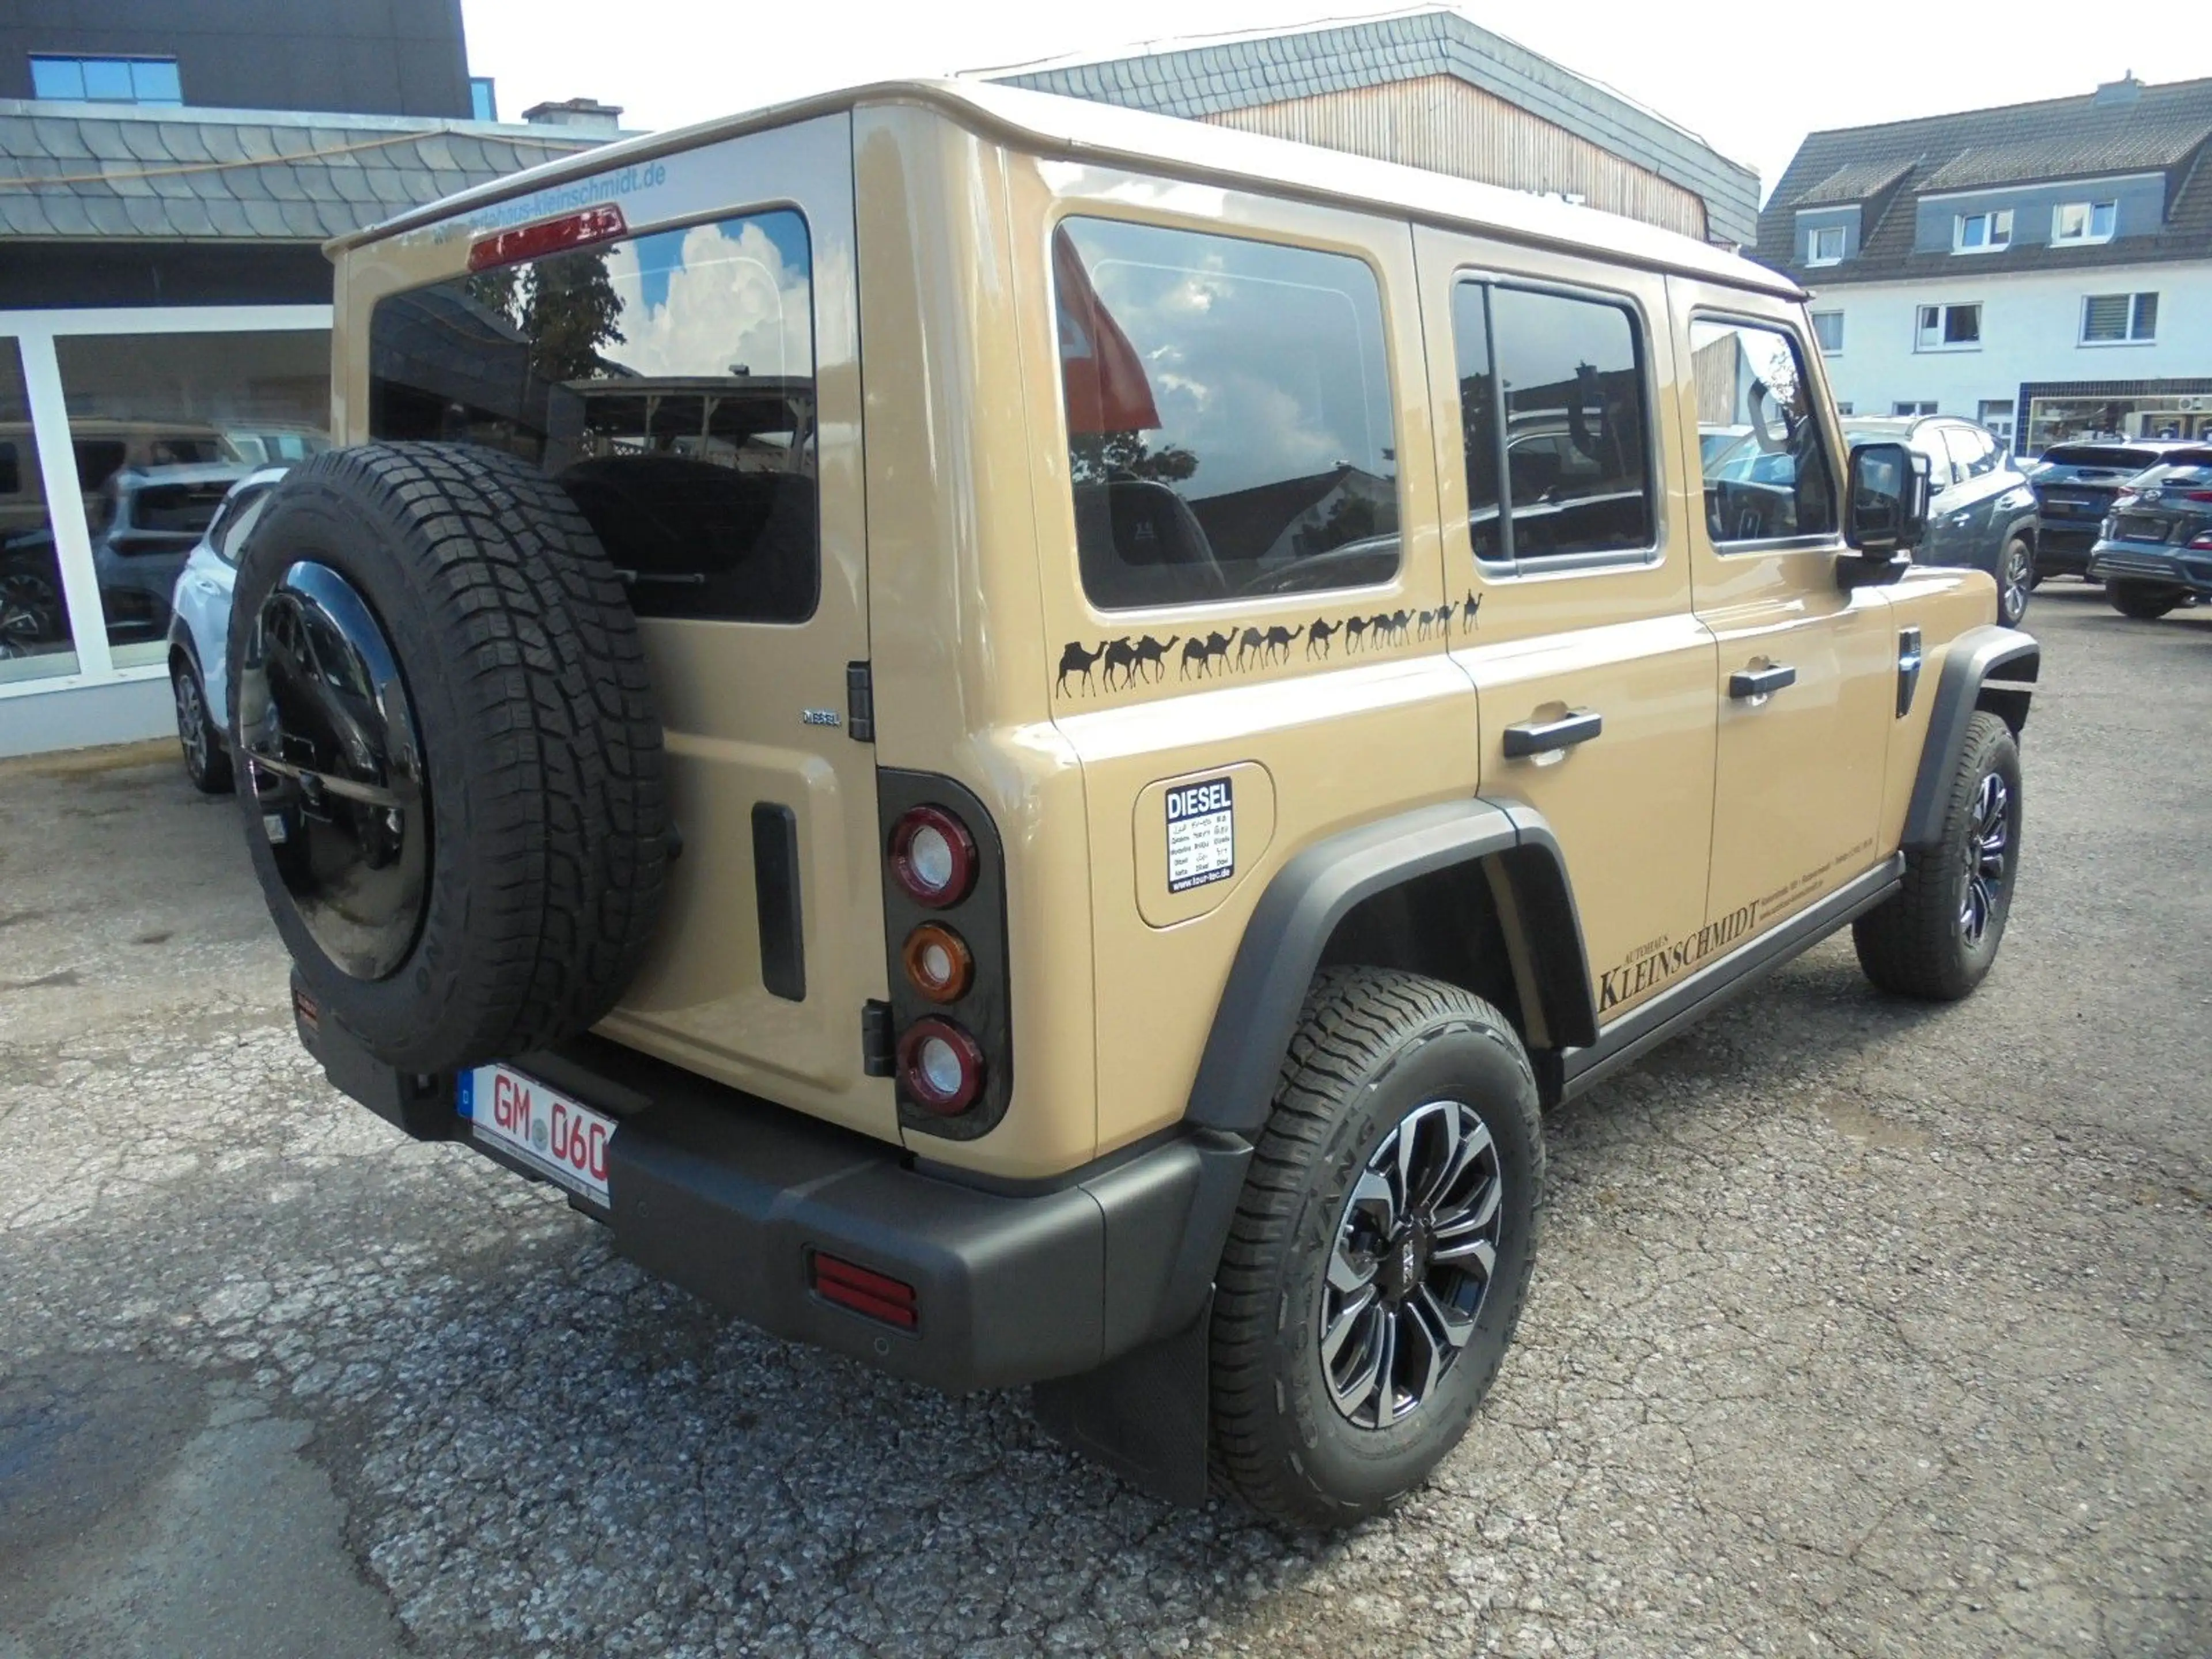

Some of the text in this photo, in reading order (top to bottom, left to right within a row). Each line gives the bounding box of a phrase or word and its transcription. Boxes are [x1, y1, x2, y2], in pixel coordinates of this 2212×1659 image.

[433, 161, 666, 246] wautohaus-kleinschmidt.de
[1168, 783, 1232, 819] DIESEL
[1597, 899, 1760, 1013] KLEINSCHMIDT
[494, 1073, 611, 1181] GM 060
